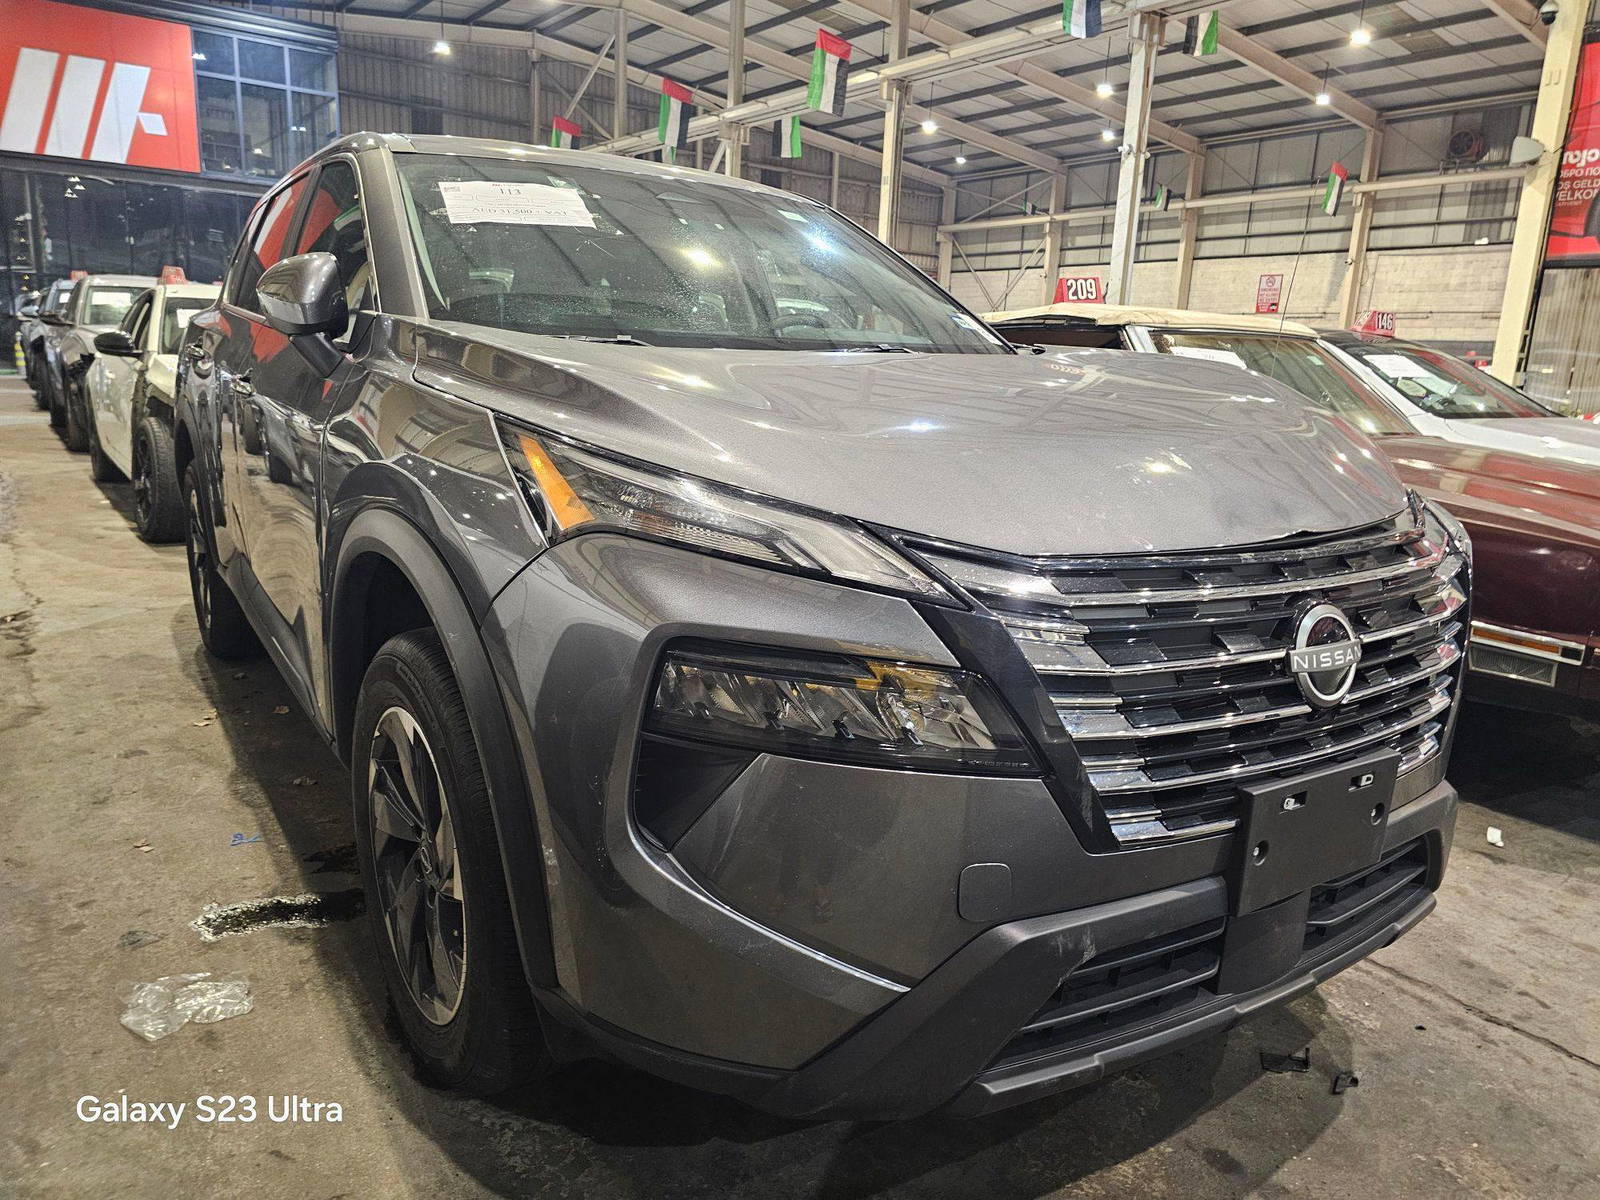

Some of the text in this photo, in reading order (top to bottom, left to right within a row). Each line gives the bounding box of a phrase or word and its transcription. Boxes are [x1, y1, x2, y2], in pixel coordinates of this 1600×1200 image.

[1066, 279, 1097, 300] 209
[1377, 313, 1393, 330] 146
[1293, 646, 1361, 669] NISSAN
